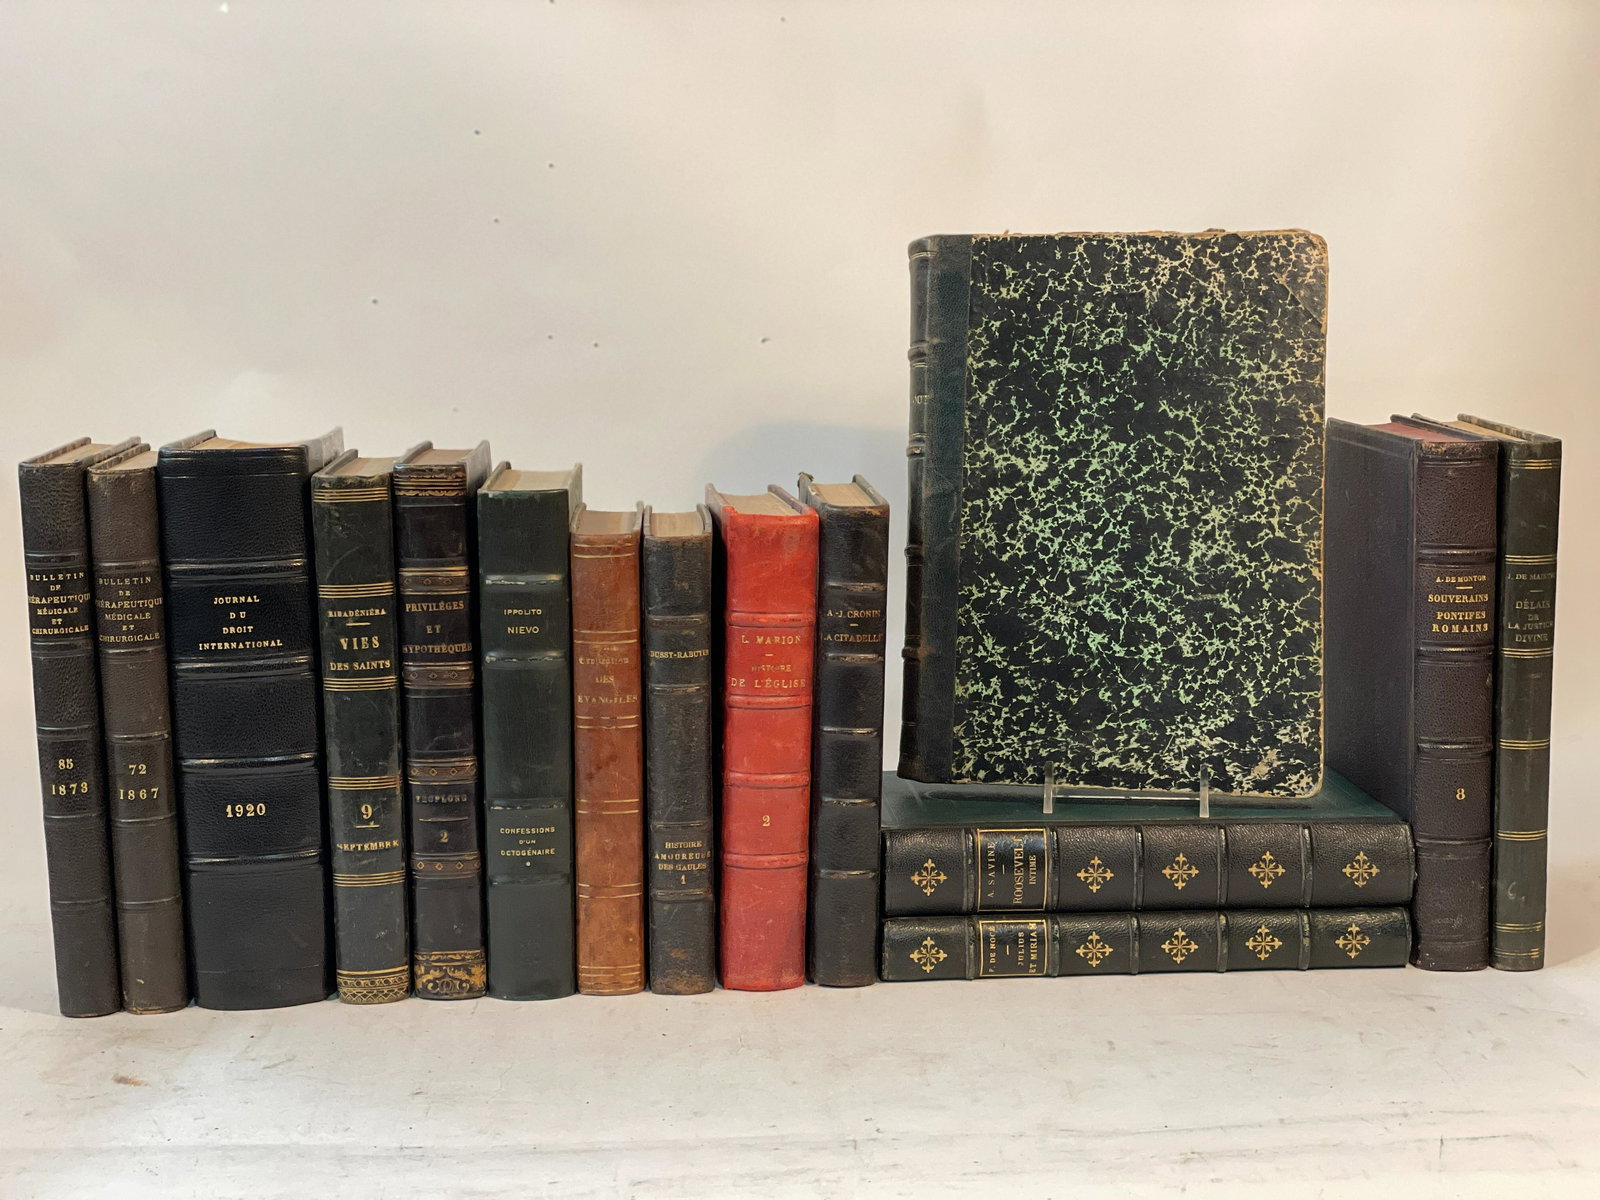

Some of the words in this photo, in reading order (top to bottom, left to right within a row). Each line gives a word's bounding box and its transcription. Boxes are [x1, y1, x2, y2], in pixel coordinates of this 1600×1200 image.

[29, 572, 84, 581] BULLETIN
[98, 576, 151, 586] BULLETIN
[213, 595, 260, 605] JOURNAL
[1428, 594, 1489, 603] SOUVERAINS
[104, 612, 152, 620] MÉDICALE
[229, 611, 246, 620] DU
[1436, 610, 1486, 620] PONTIFES
[222, 626, 254, 634] DROIT
[426, 624, 442, 634] ET
[507, 626, 540, 634] NIEVO
[1432, 623, 1488, 633] ROMAINS
[100, 633, 160, 643] CHIRURGICALE
[340, 636, 380, 650] VIES
[198, 639, 283, 650] INTERNATIONAL
[329, 661, 350, 671] DES
[353, 660, 391, 670] SAINTS
[731, 678, 746, 688] DE
[58, 758, 74, 770] 85
[128, 764, 147, 776] 72
[51, 782, 88, 796] 1873
[120, 788, 159, 800] 1867
[1456, 788, 1466, 800] 8
[226, 803, 266, 818] 1920
[361, 804, 373, 820] 9
[762, 815, 771, 827] 2
[500, 826, 556, 834] CONFESSIONS
[439, 831, 449, 843] 2
[665, 841, 702, 849] HISTOIRE
[987, 841, 996, 886] SAVINE
[1028, 855, 1037, 885] INTIME
[680, 874, 687, 885] 1
